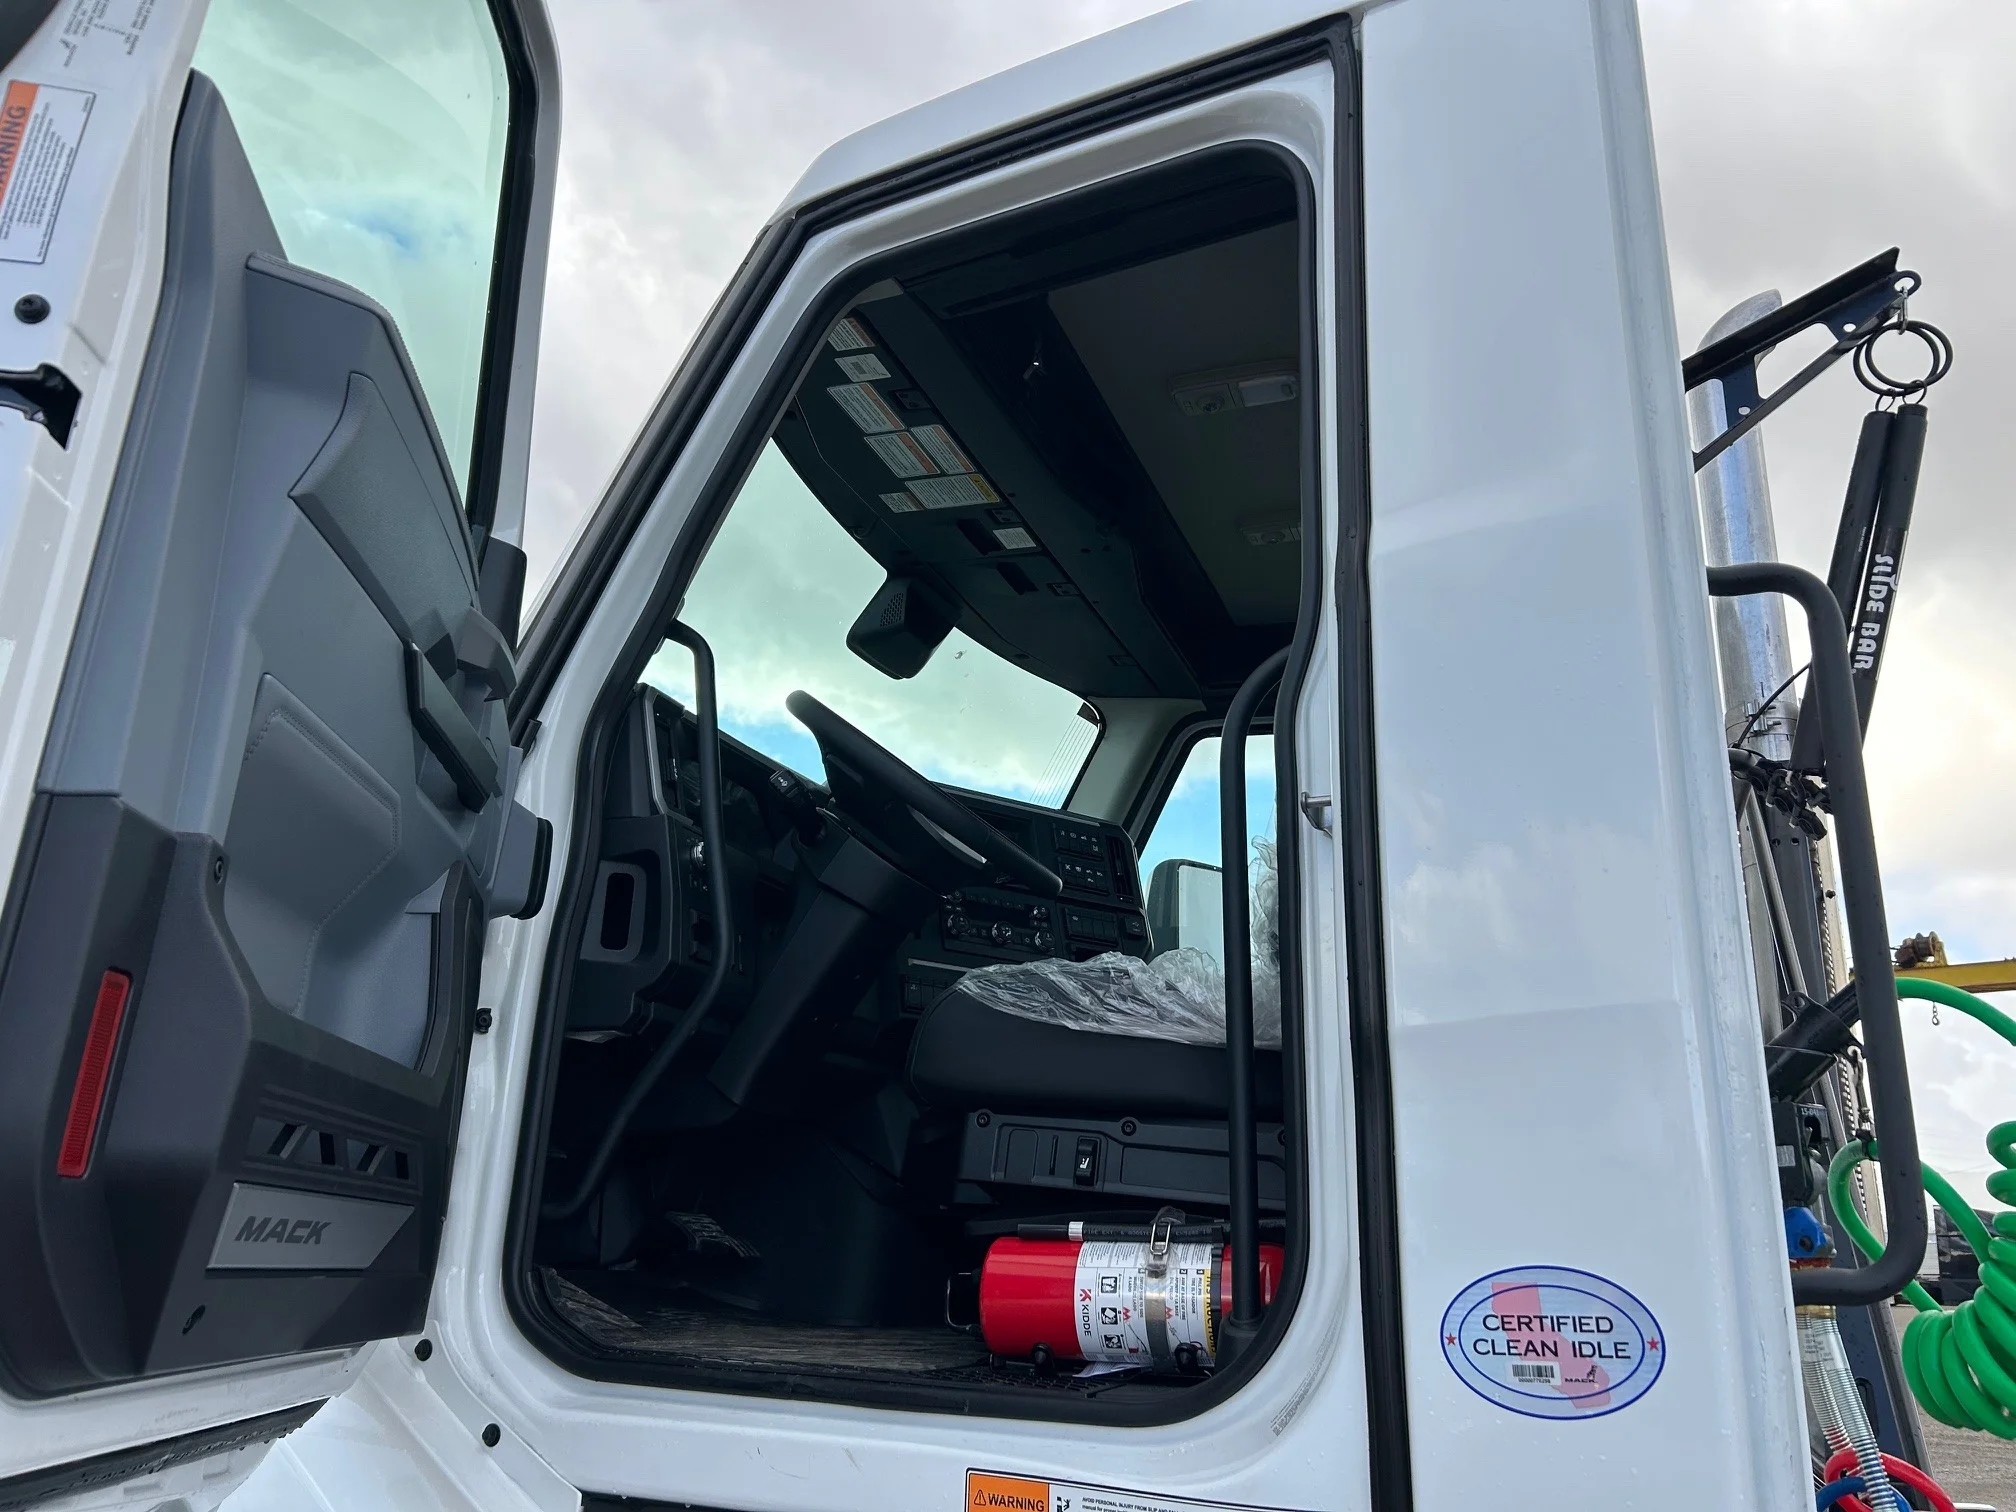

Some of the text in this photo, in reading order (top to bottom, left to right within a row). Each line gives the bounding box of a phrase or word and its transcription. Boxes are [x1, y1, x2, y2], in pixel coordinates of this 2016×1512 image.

[0, 106, 26, 184] RNING
[1853, 554, 1897, 669] SLIDE BAR
[234, 1216, 332, 1245] MACK
[1081, 1304, 1092, 1337] KIDDE
[1482, 1314, 1614, 1334] CERTIFIED
[1473, 1338, 1632, 1360] CLEAN IDLE
[988, 1493, 1045, 1512] WARNING
[1095, 1499, 1118, 1508] PERSONAL
[1118, 1501, 1134, 1510] INJURY
[1134, 1504, 1147, 1512] FROM
